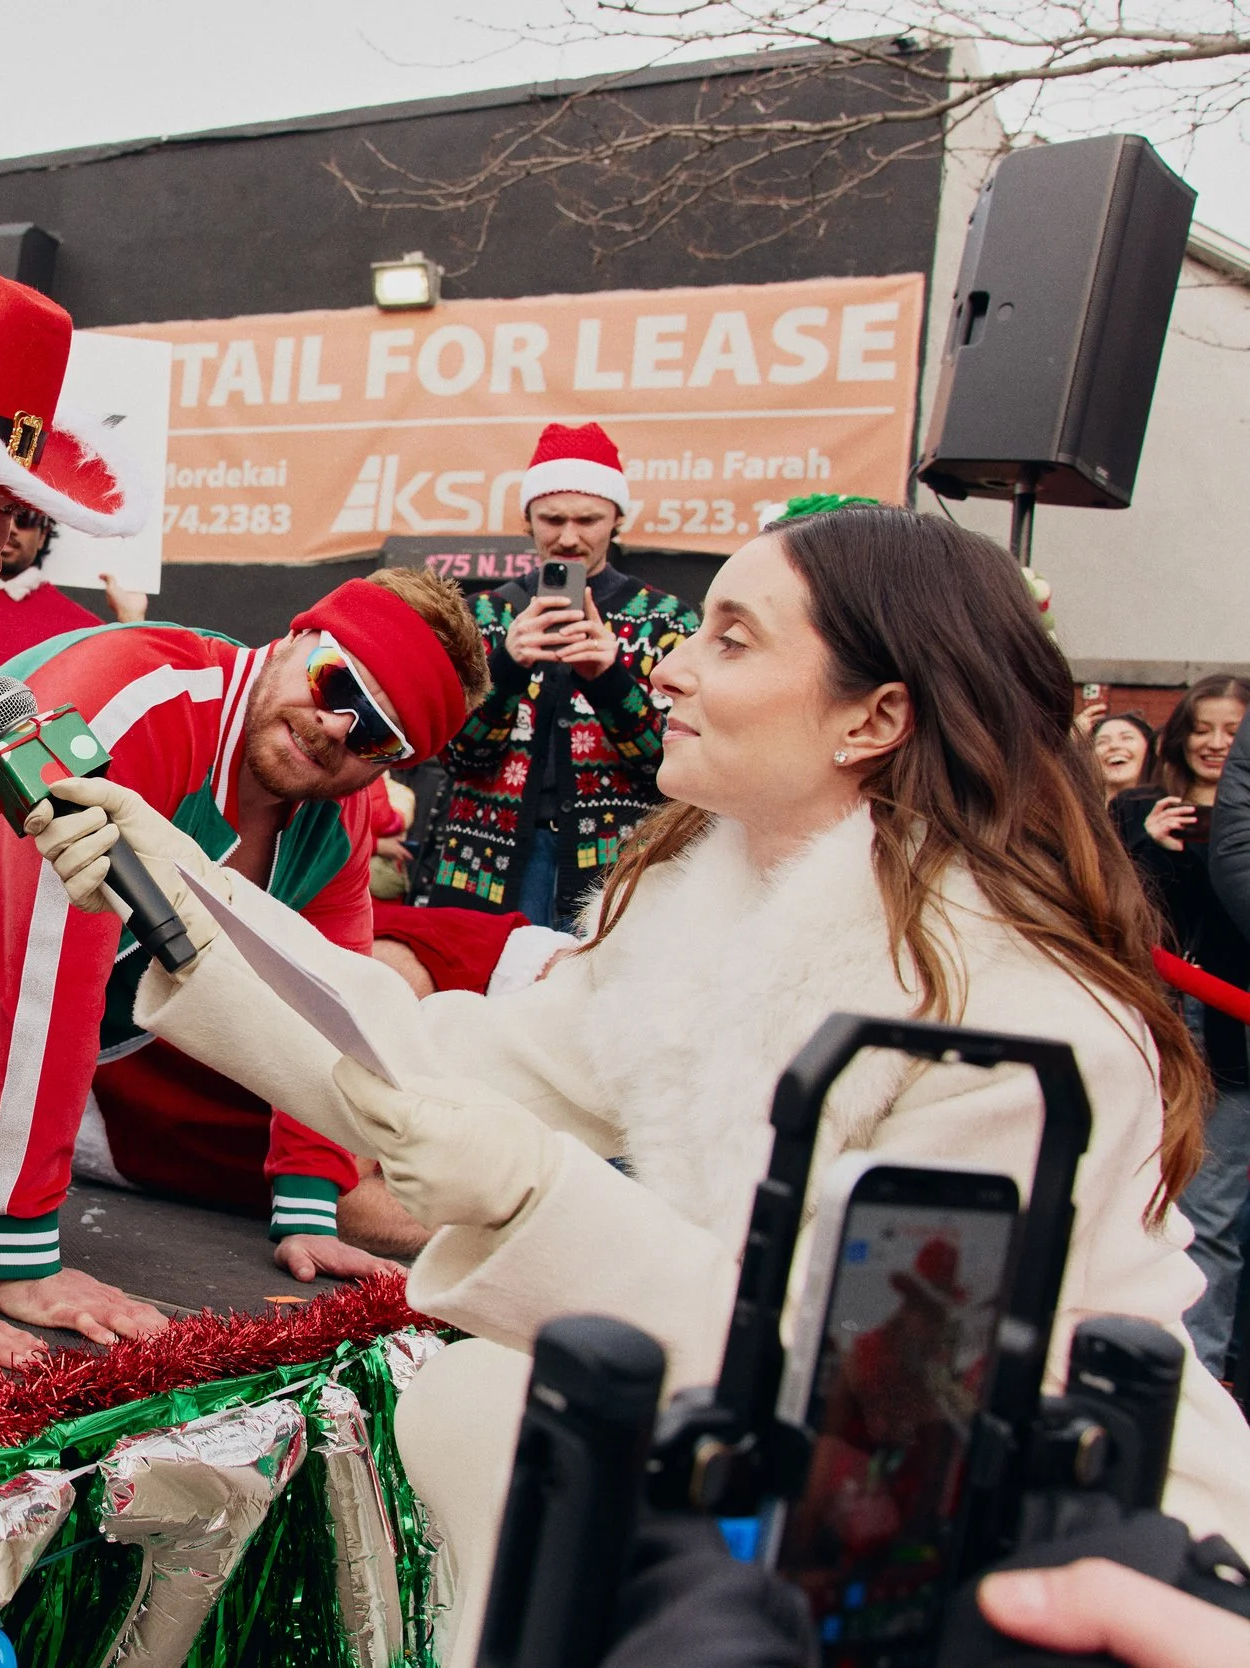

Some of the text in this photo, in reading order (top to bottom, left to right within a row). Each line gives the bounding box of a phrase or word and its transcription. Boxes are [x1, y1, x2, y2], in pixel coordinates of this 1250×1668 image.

[173, 302, 900, 408] TAIL FOR LEASE
[618, 448, 831, 480] amia Farah
